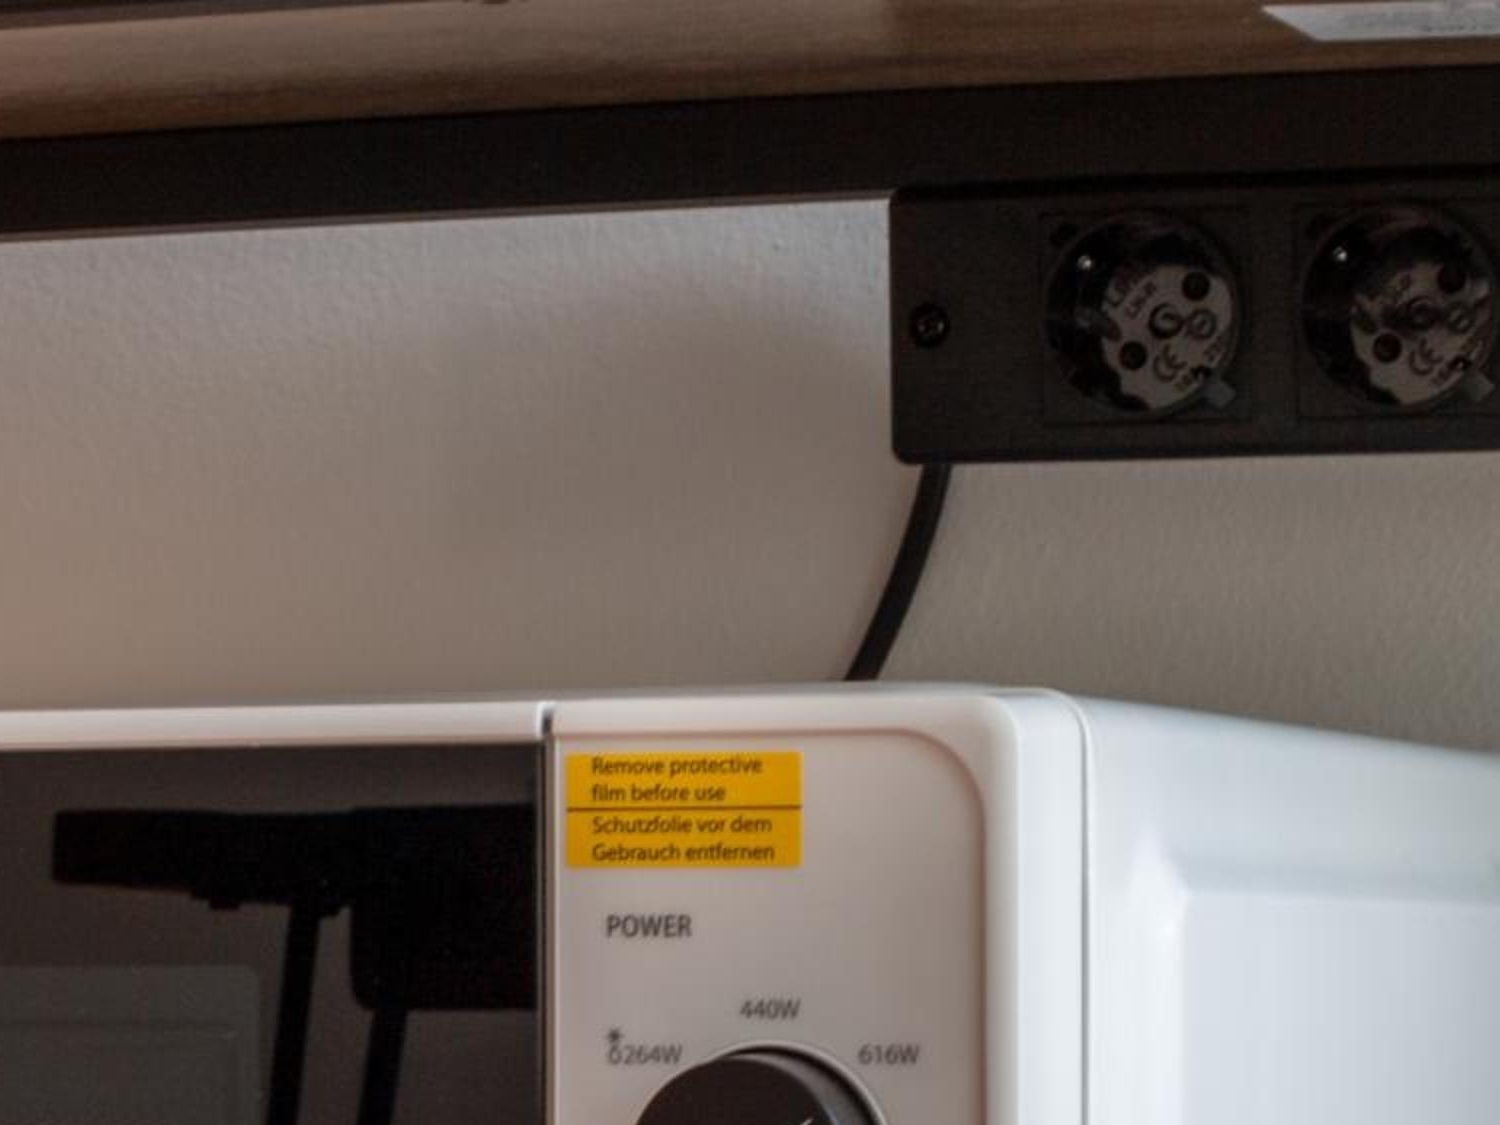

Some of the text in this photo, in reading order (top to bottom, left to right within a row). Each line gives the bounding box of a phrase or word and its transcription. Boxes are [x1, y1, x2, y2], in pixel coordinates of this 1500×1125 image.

[591, 755, 763, 776] Remove protective
[591, 783, 727, 802] film before use
[591, 814, 773, 834] Schutzfolie vor dem
[591, 842, 775, 862] Gebrauch entfernen
[606, 914, 692, 938] POWER
[740, 1000, 799, 1019] 440W
[857, 1044, 919, 1065] 616W
